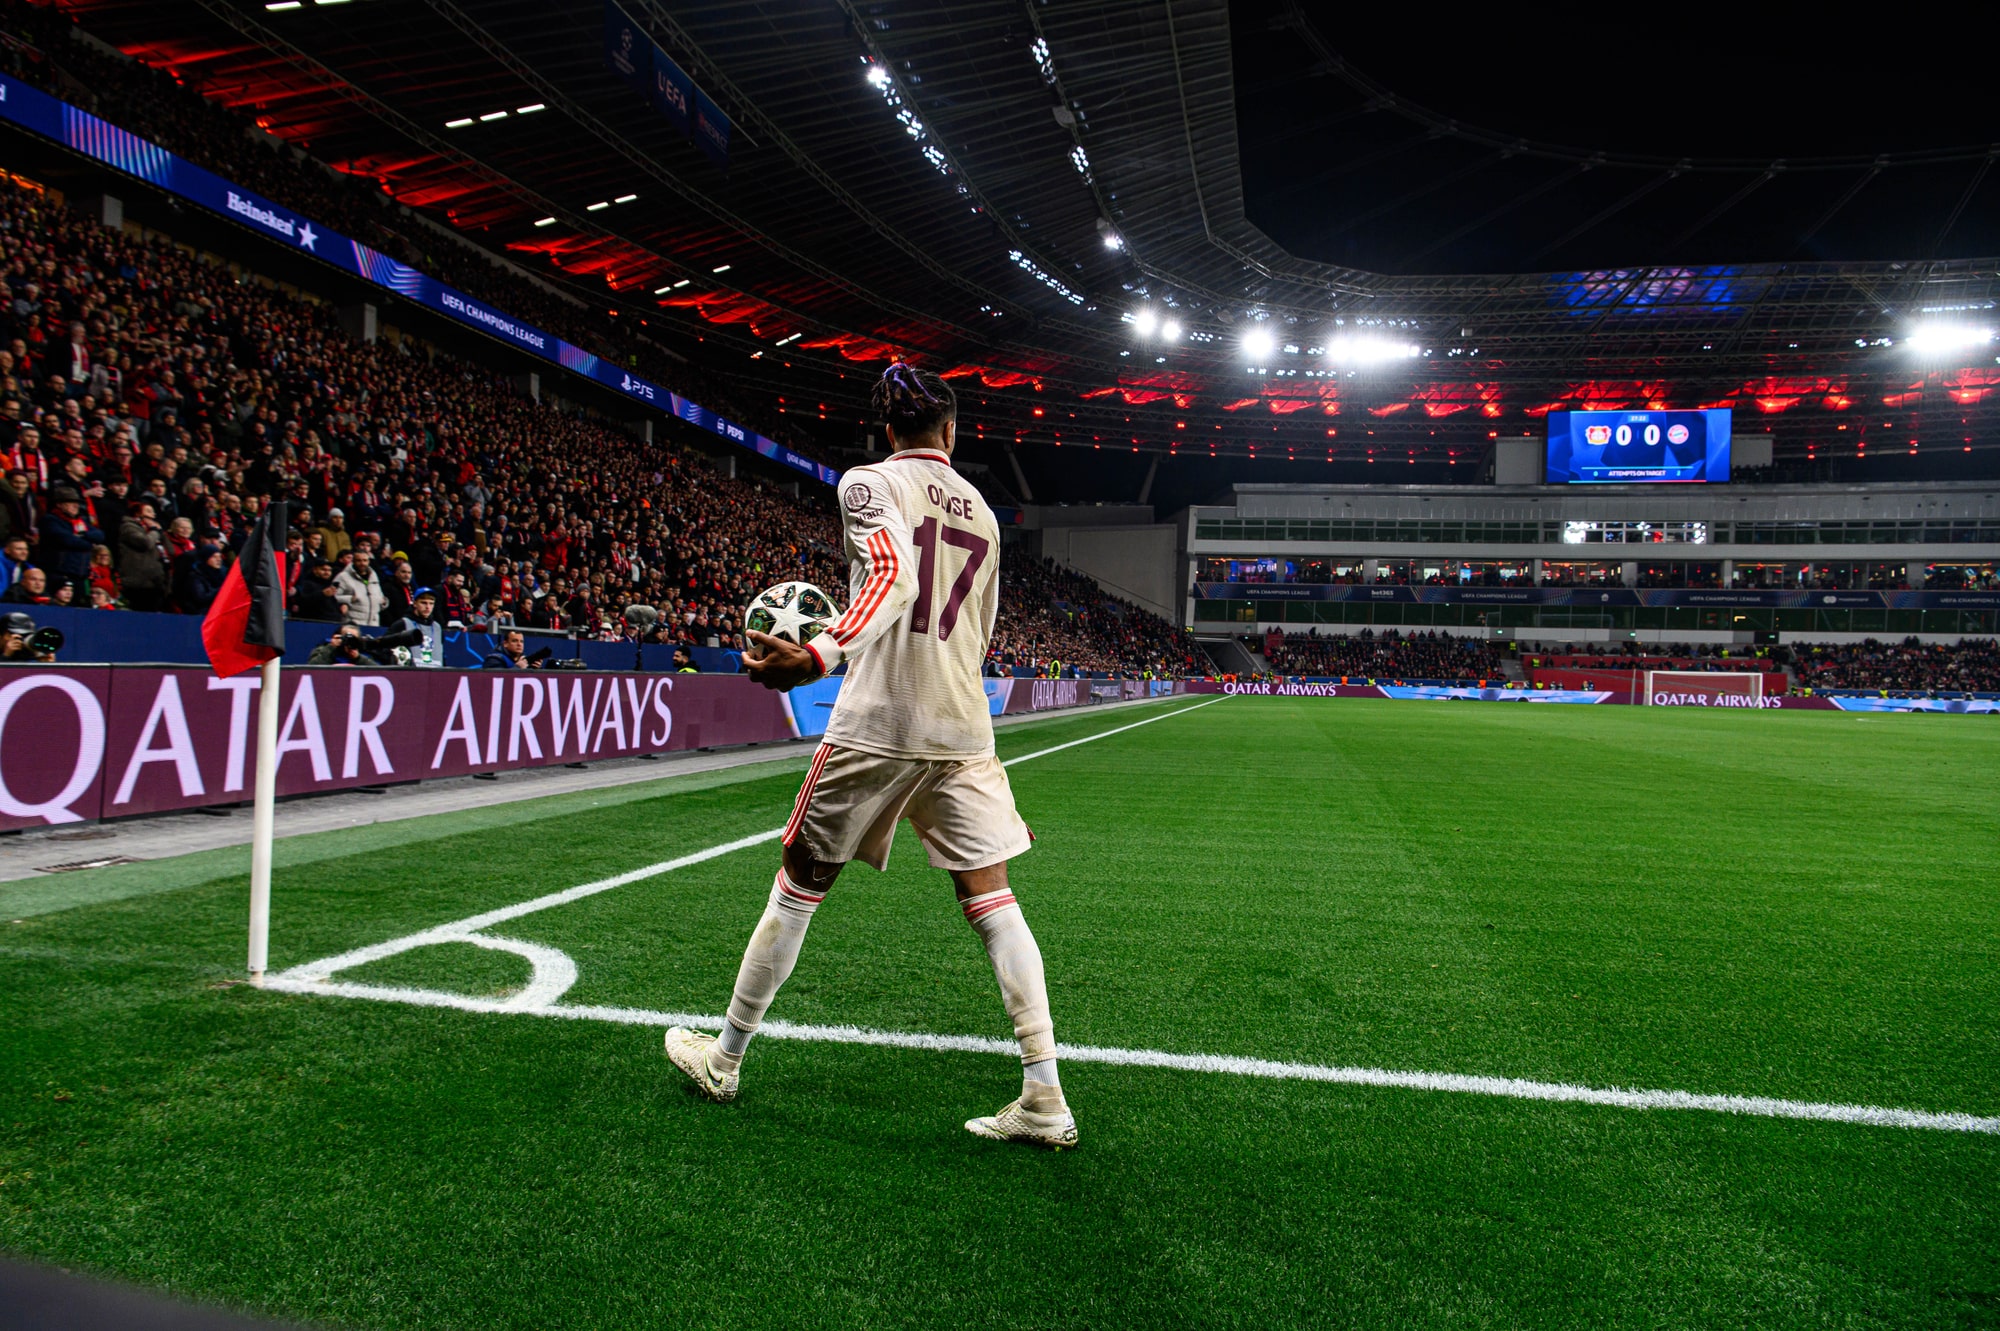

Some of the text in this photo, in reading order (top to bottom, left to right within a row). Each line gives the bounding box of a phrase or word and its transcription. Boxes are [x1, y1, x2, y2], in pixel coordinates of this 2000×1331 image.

[657, 71, 687, 115] UEFA
[227, 191, 294, 237] Heineken
[442, 292, 545, 349] UEFA CHAMPIONS LEAGUE
[633, 380, 655, 400] PS5
[727, 424, 744, 441] PEPSI
[1616, 424, 1660, 446] 0 0
[927, 484, 974, 521] OLISE
[910, 515, 989, 642] 17
[1032, 680, 1055, 711] QATAR
[1224, 682, 1336, 697] QATAR AIRWAYS
[1654, 693, 1782, 708] QATAR AIRWAYS
[0, 674, 673, 824] QATAR AIRWAYS
